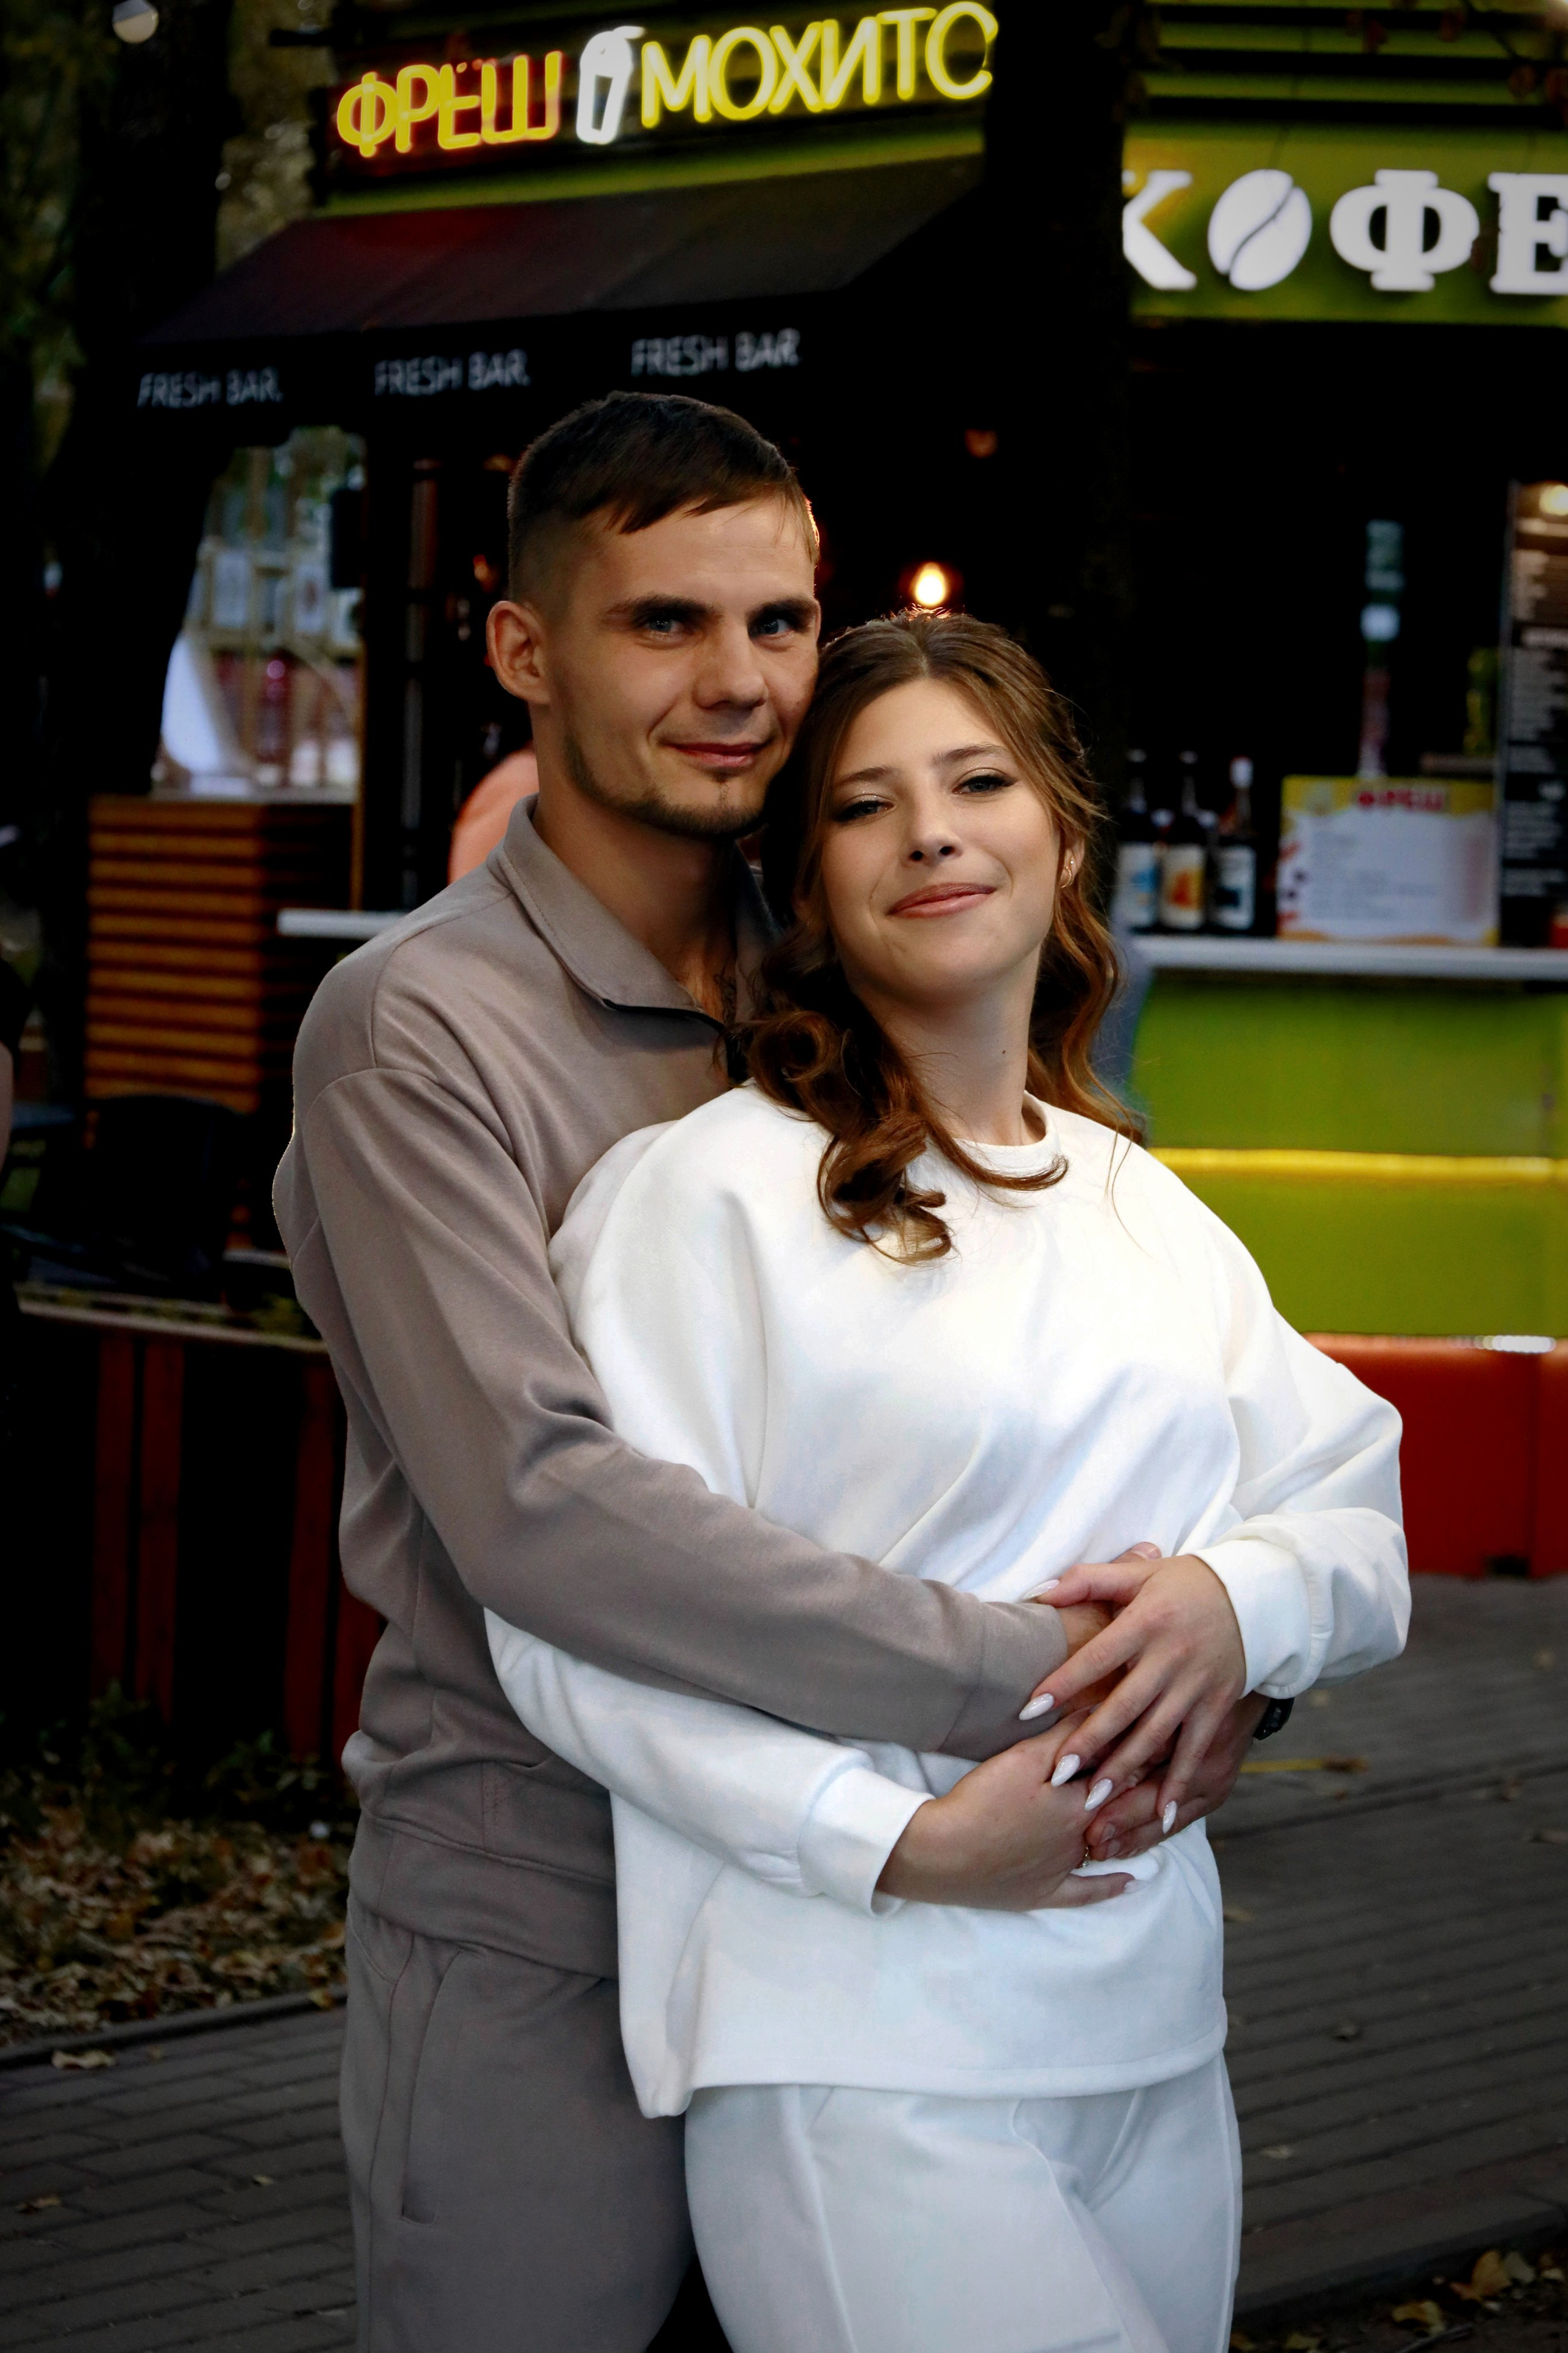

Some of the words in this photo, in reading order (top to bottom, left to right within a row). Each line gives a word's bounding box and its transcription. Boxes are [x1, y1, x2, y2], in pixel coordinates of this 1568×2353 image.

[374, 355, 463, 396] FRESH
[468, 348, 532, 391] BAR
[631, 334, 729, 377] FRESH
[735, 327, 801, 372] BAR
[137, 371, 222, 408] FRESH
[226, 366, 284, 406] BAR
